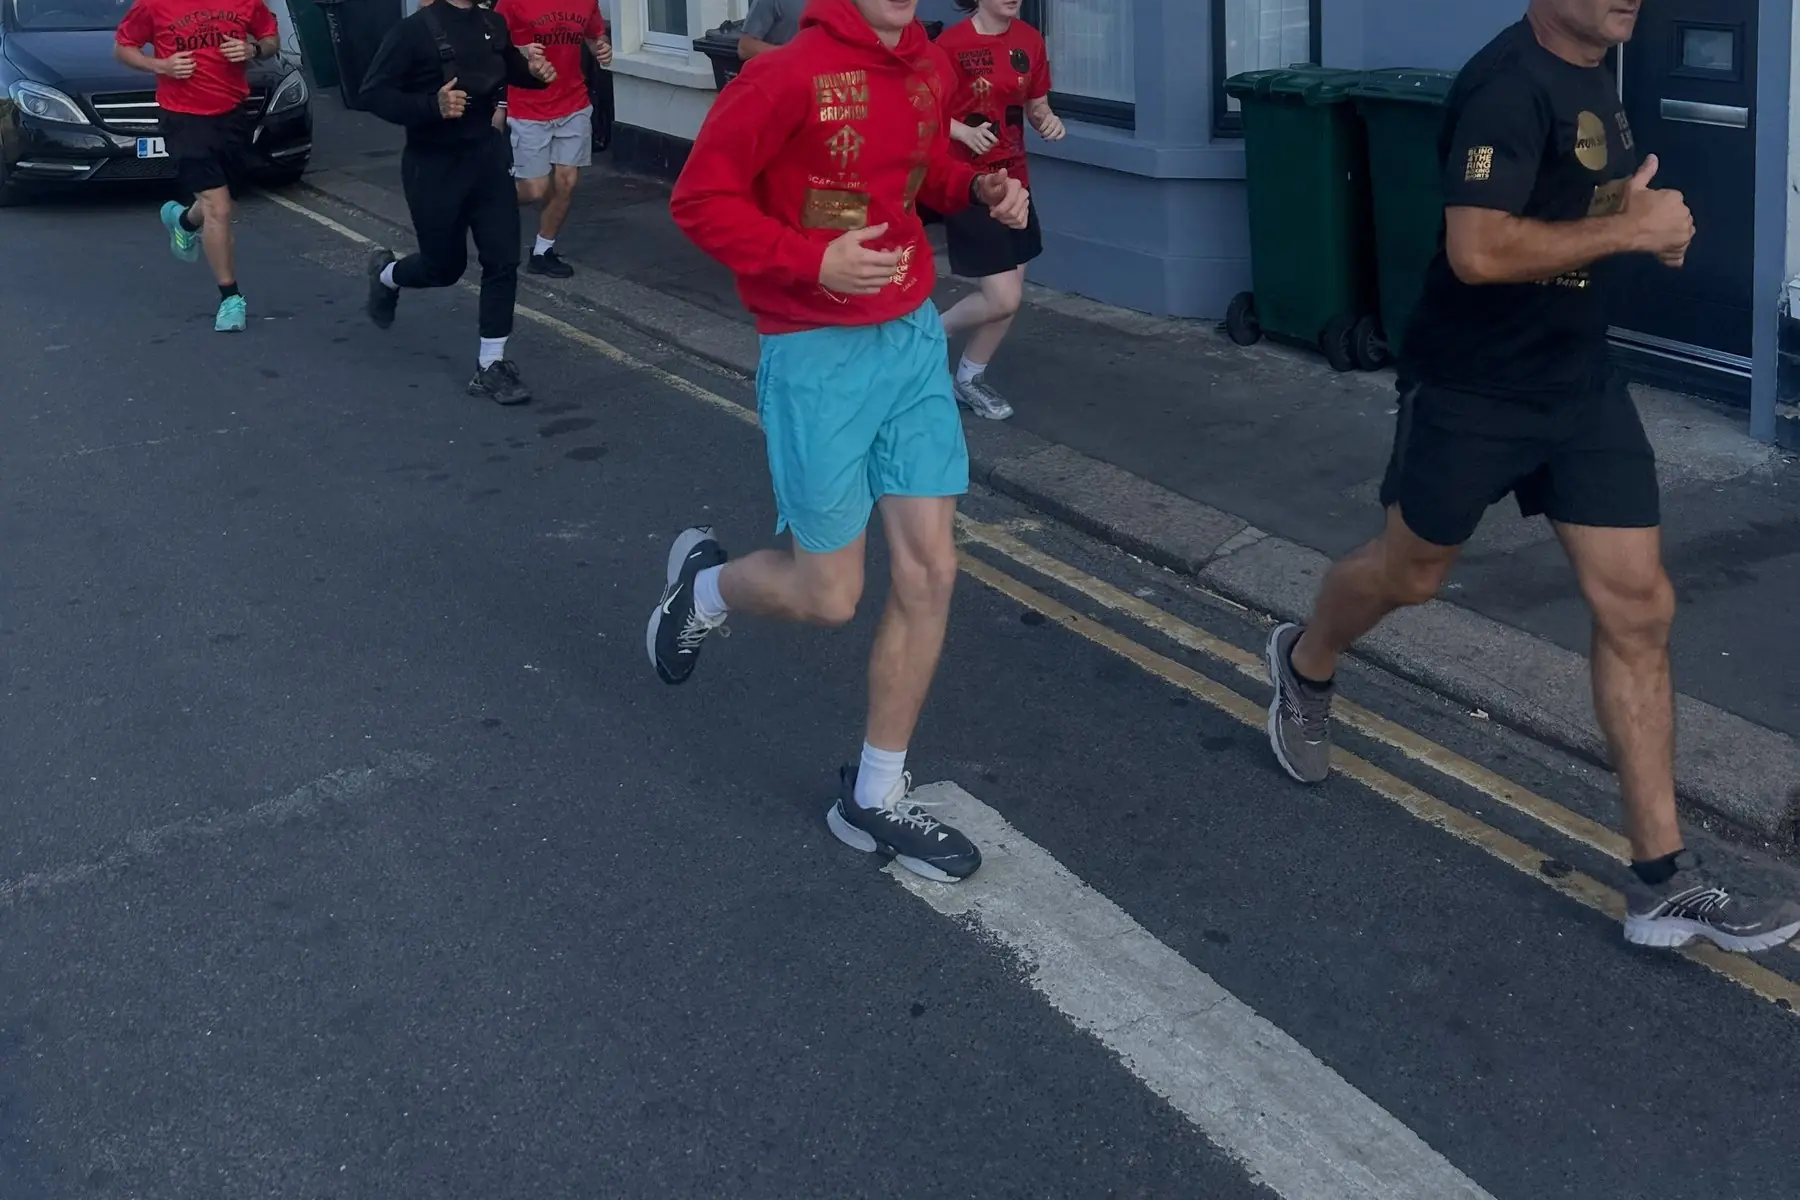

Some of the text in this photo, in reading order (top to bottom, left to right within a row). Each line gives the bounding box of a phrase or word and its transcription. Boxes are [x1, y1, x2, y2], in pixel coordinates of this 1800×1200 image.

[168, 9, 242, 33] PORTSLADE
[530, 11, 587, 28] PORTSLADE
[533, 31, 583, 45] BOXING
[820, 105, 868, 122] BRIGHTON
[1467, 161, 1491, 169] RING
